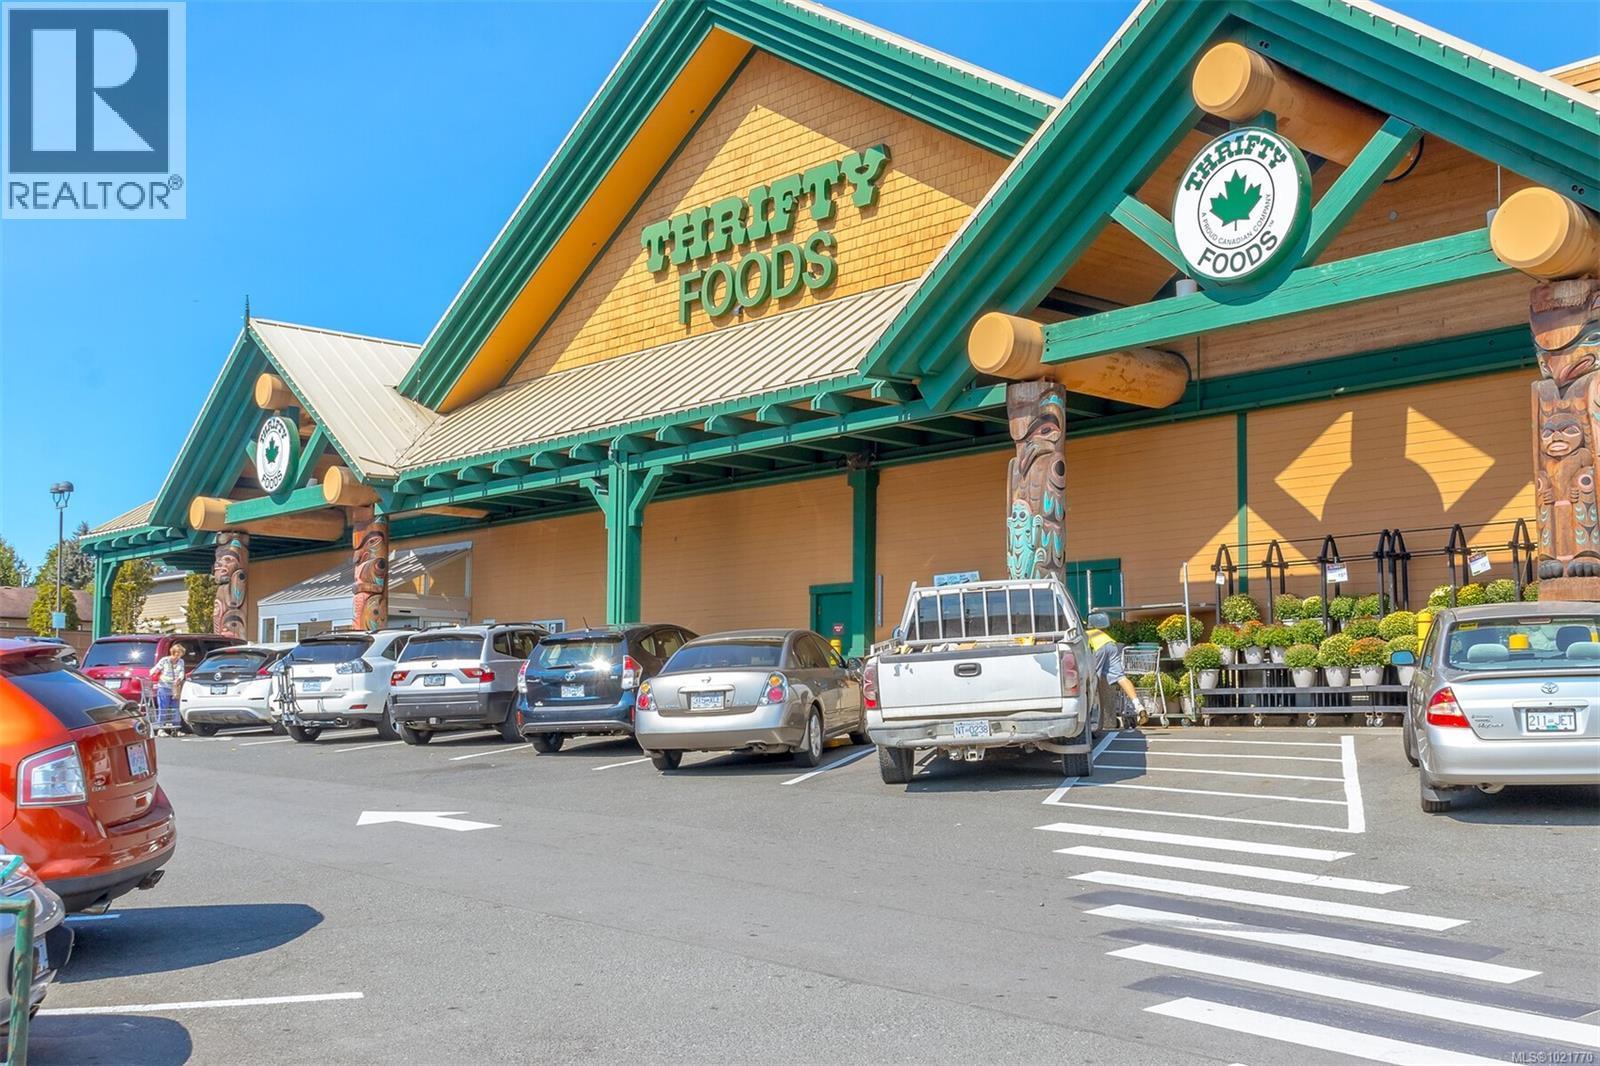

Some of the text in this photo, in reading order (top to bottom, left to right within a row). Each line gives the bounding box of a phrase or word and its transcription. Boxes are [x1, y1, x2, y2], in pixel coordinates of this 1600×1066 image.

[1184, 134, 1288, 192] THRIFTY
[640, 143, 892, 273] THRIFTY
[1203, 218, 1218, 241] PROUD
[1217, 231, 1253, 245] CANADIAN
[1253, 193, 1271, 232] COMPANY
[678, 230, 837, 325] FOODS
[1197, 230, 1278, 274] FOODS
[262, 470, 282, 489] FOODS
